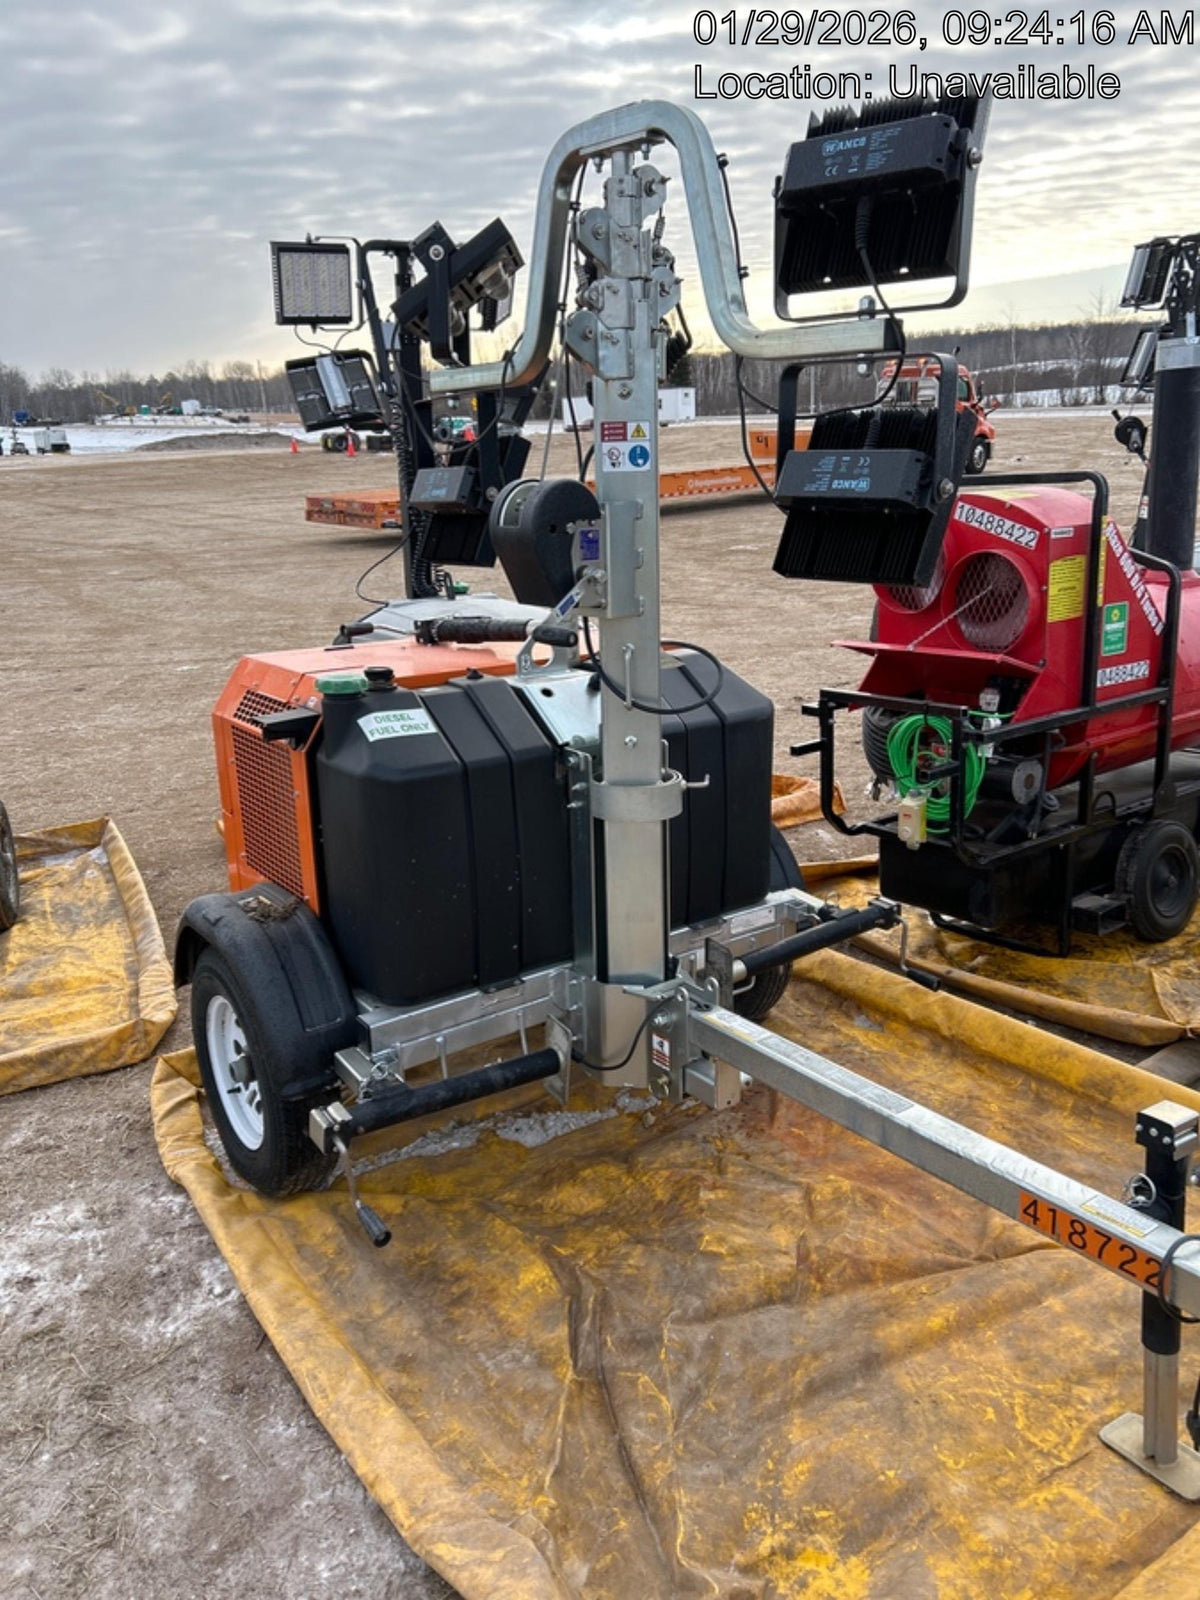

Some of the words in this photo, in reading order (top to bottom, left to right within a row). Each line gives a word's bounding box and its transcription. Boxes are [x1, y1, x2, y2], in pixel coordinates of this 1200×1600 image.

[958, 504, 1037, 549] 10488422
[1099, 661, 1149, 685] 0488422
[368, 725, 400, 738] FUEL
[400, 722, 429, 733] ONLY
[373, 712, 415, 724] DIESEL
[1022, 1199, 1162, 1289] 418722
